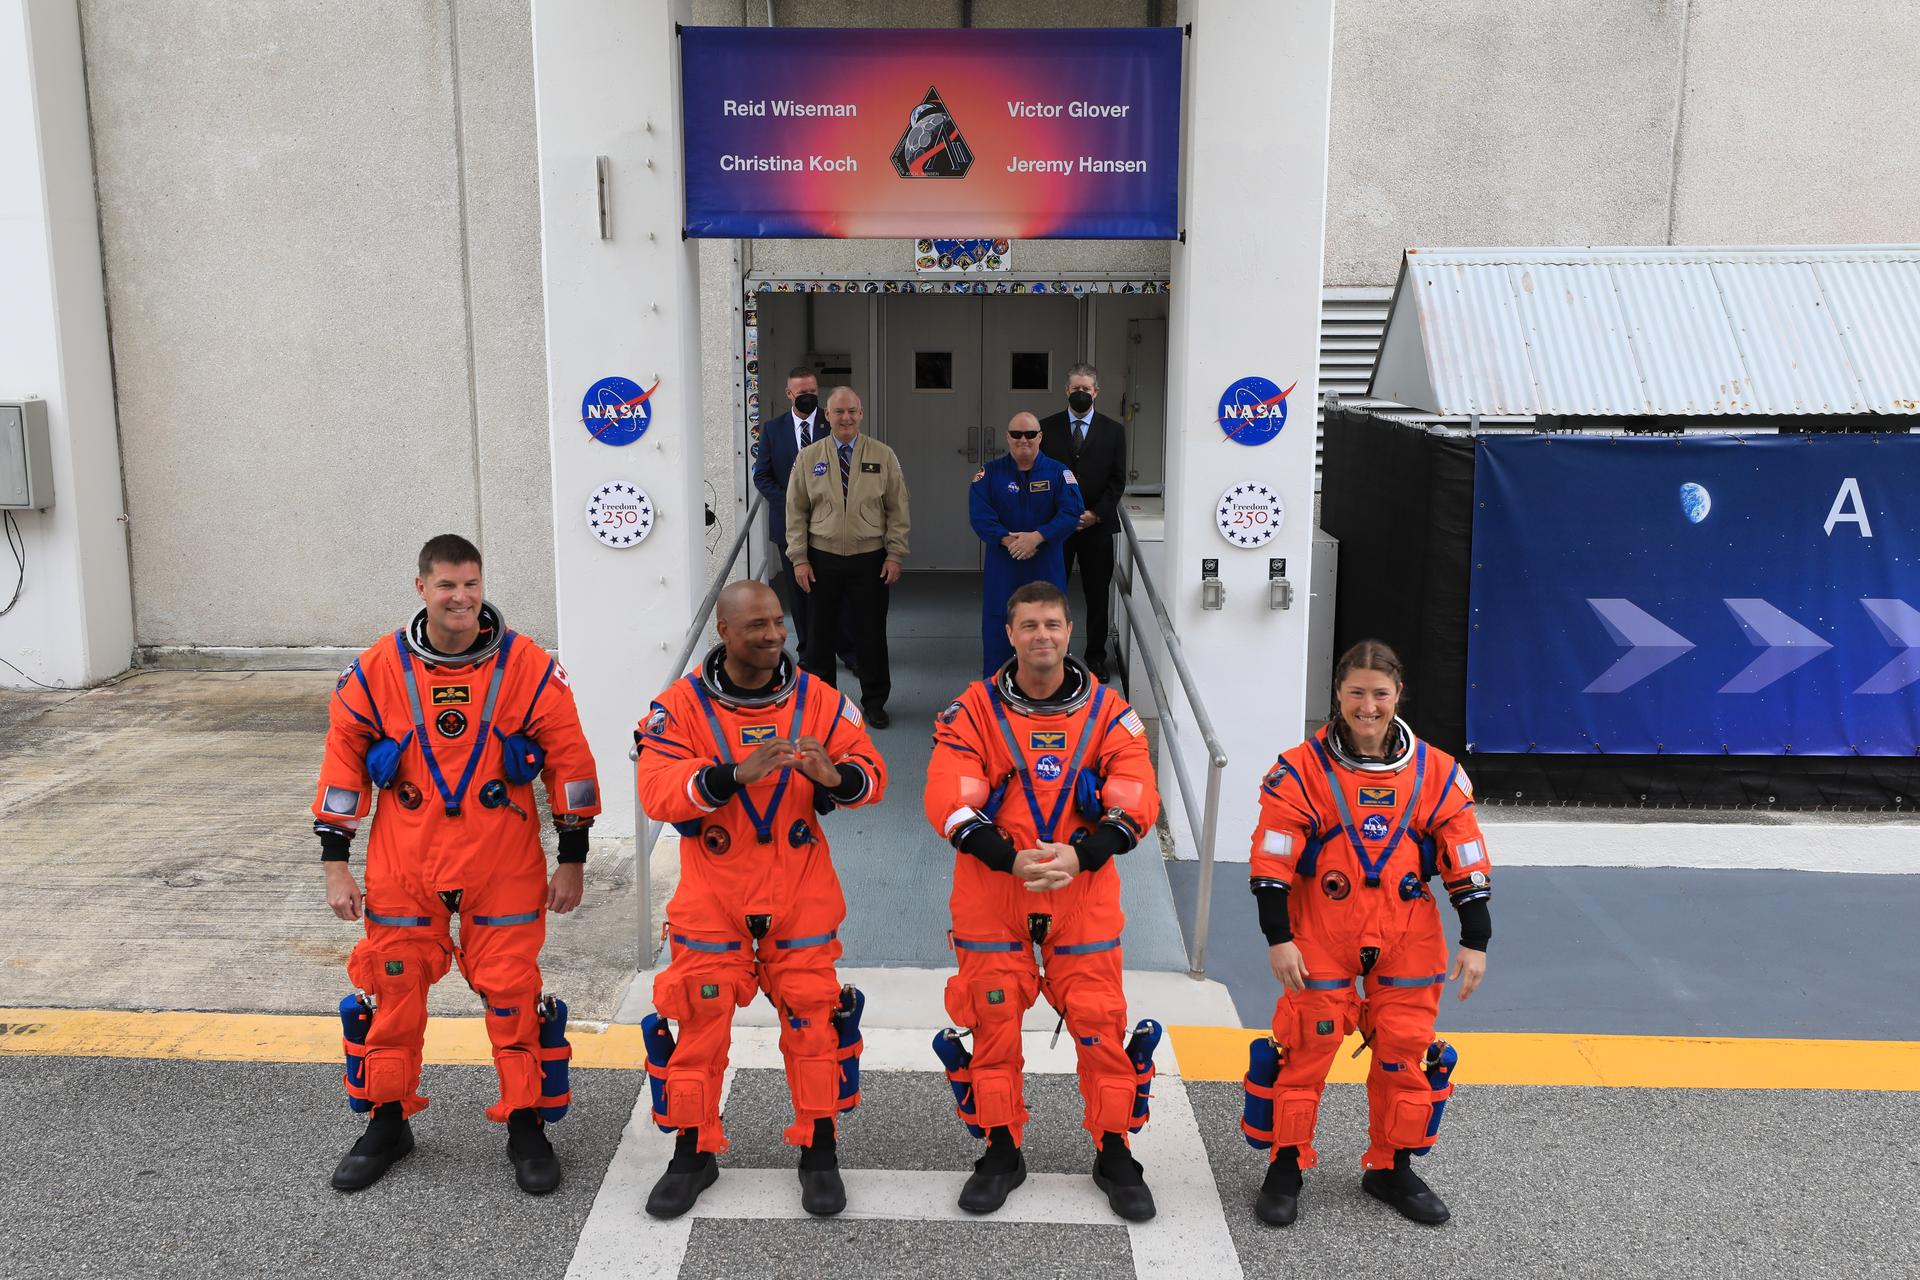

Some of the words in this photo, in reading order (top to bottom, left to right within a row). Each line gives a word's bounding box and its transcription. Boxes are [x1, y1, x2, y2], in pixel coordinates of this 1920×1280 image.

[724, 101, 766, 117] Reid
[771, 101, 857, 117] Wiseman
[1007, 101, 1063, 118] Victor
[1068, 101, 1130, 118] Glover
[720, 155, 804, 172] Christina
[809, 155, 858, 172] Koch
[1007, 156, 1074, 177] Jeremy
[1079, 156, 1147, 174] Hansen
[587, 404, 648, 419] NASA
[1223, 404, 1284, 419] NASA
[601, 503, 638, 511] Freedom
[1232, 503, 1269, 511] Freedom
[1823, 477, 1873, 538] A
[603, 511, 638, 529] 250
[1232, 511, 1268, 529] 250
[1037, 763, 1061, 771] NASA
[1363, 823, 1388, 831] NASA
